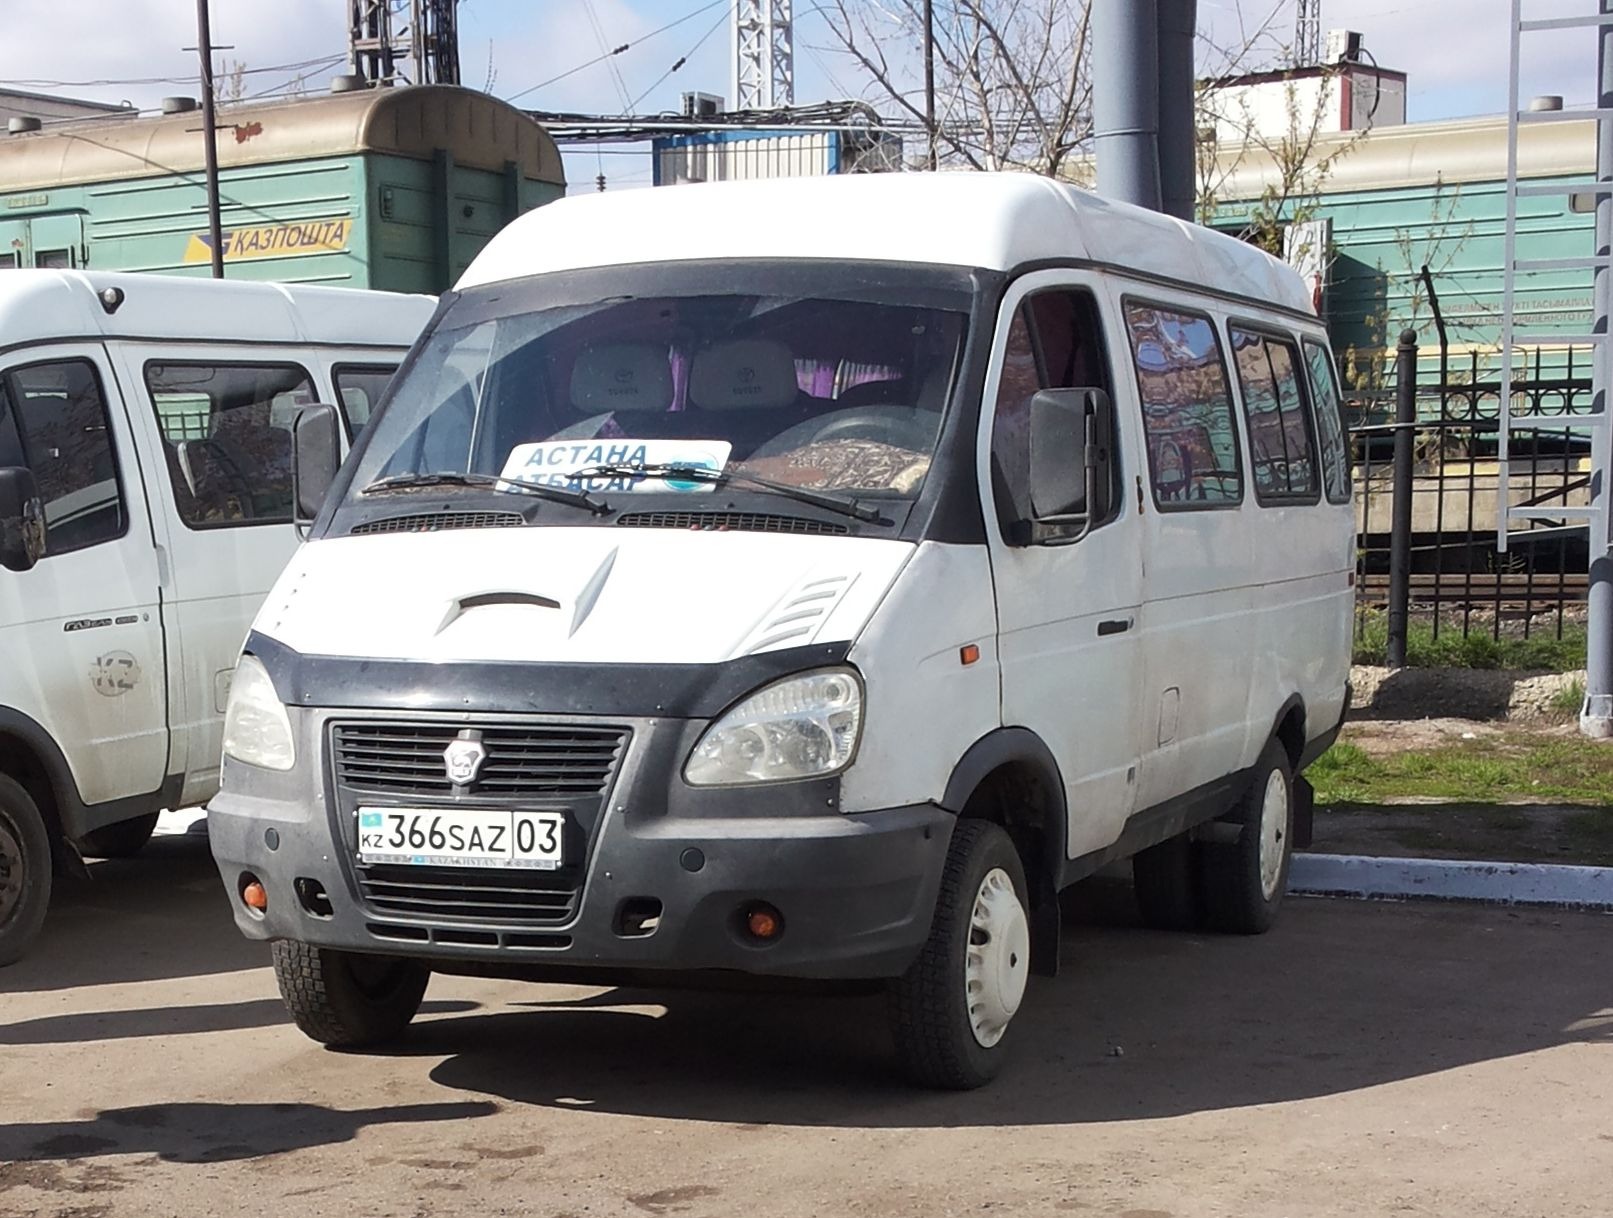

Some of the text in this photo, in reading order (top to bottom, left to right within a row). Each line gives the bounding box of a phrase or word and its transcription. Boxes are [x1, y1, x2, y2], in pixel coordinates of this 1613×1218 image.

[525, 445, 647, 467] АСТАНА
[361, 834, 383, 848] KZ
[517, 819, 557, 853] 03
